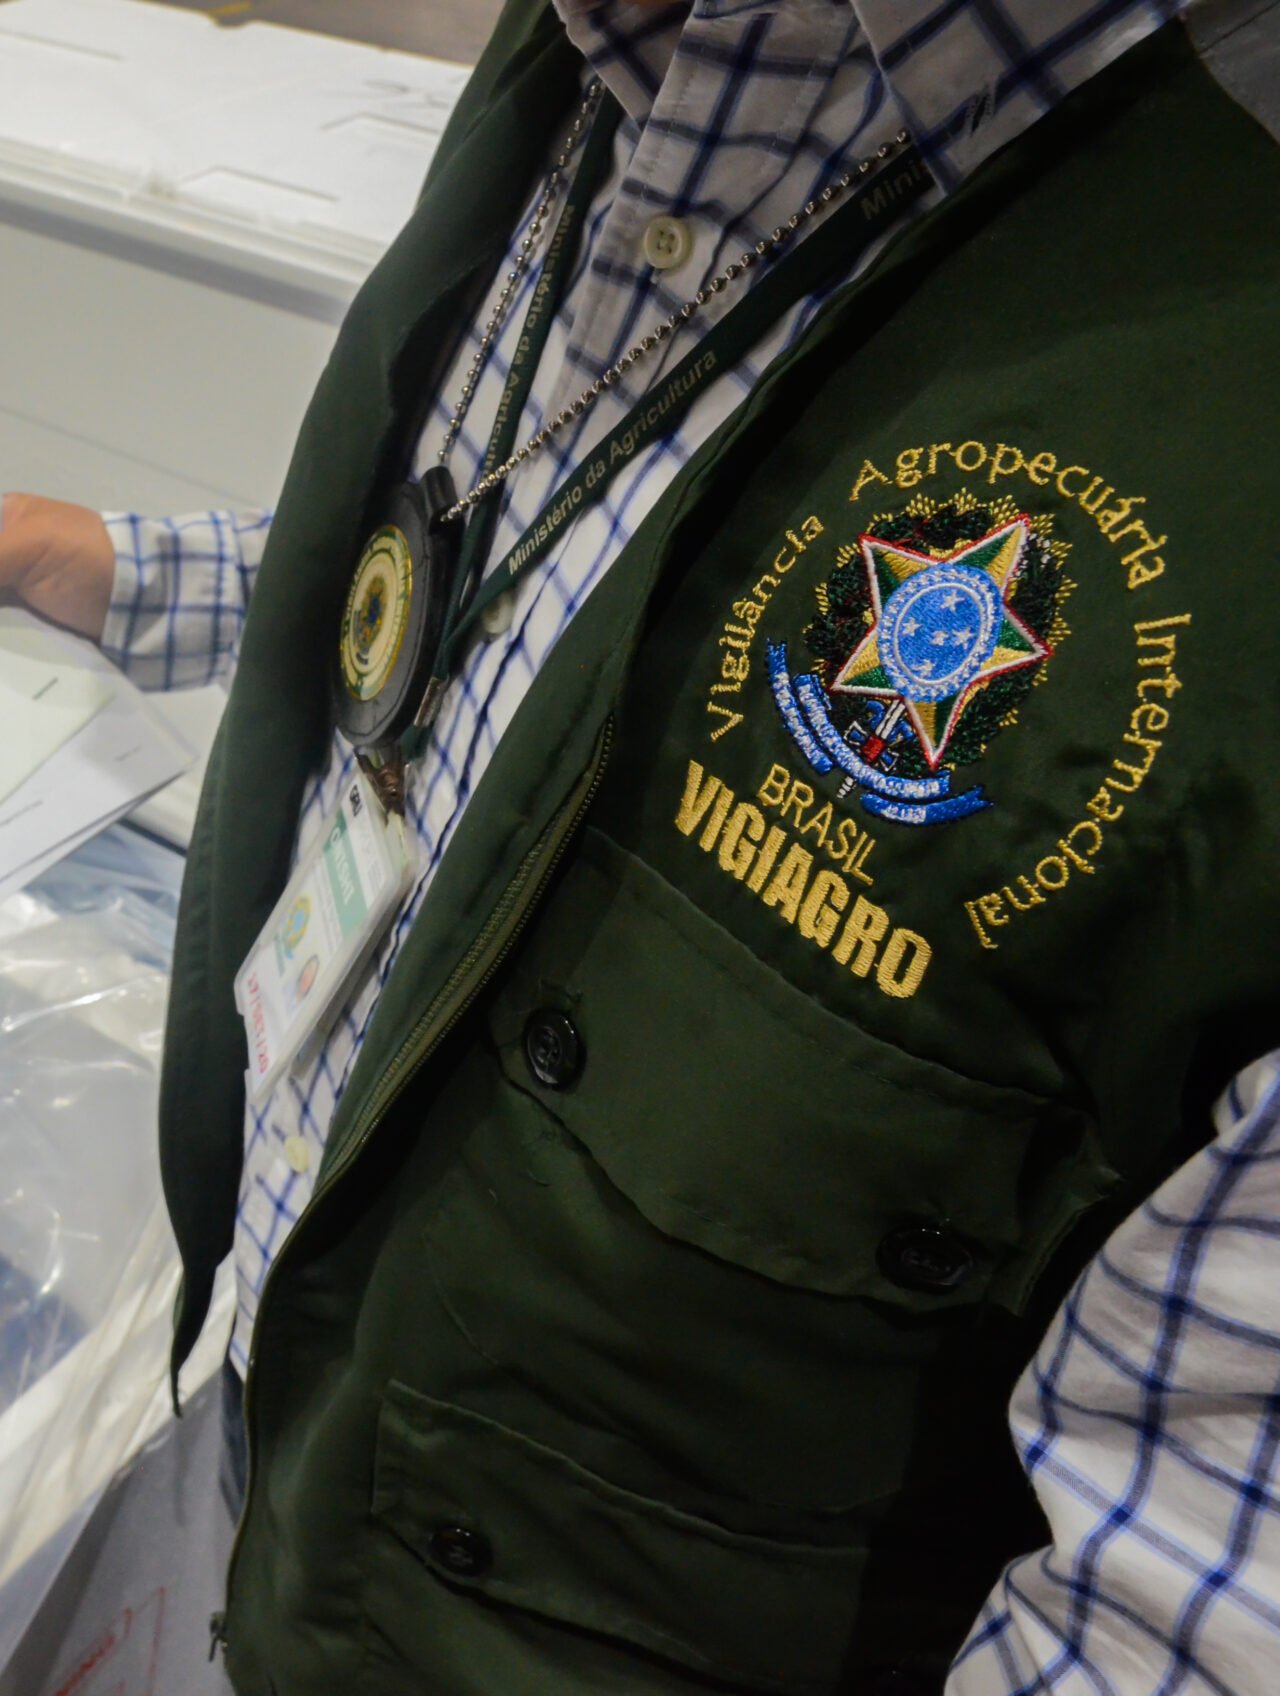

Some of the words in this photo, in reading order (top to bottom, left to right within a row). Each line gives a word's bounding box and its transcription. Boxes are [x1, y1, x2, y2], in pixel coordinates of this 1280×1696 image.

[526, 204, 576, 330] Ministério
[513, 335, 531, 365] da
[508, 485, 583, 576] Ministério
[584, 460, 607, 489] da
[609, 351, 718, 465] Agricultura
[849, 440, 1168, 592] Agropecuária
[759, 763, 876, 887] BRASIL
[964, 613, 1193, 949] Internacional
[674, 760, 933, 1000] VIGIAGRO
